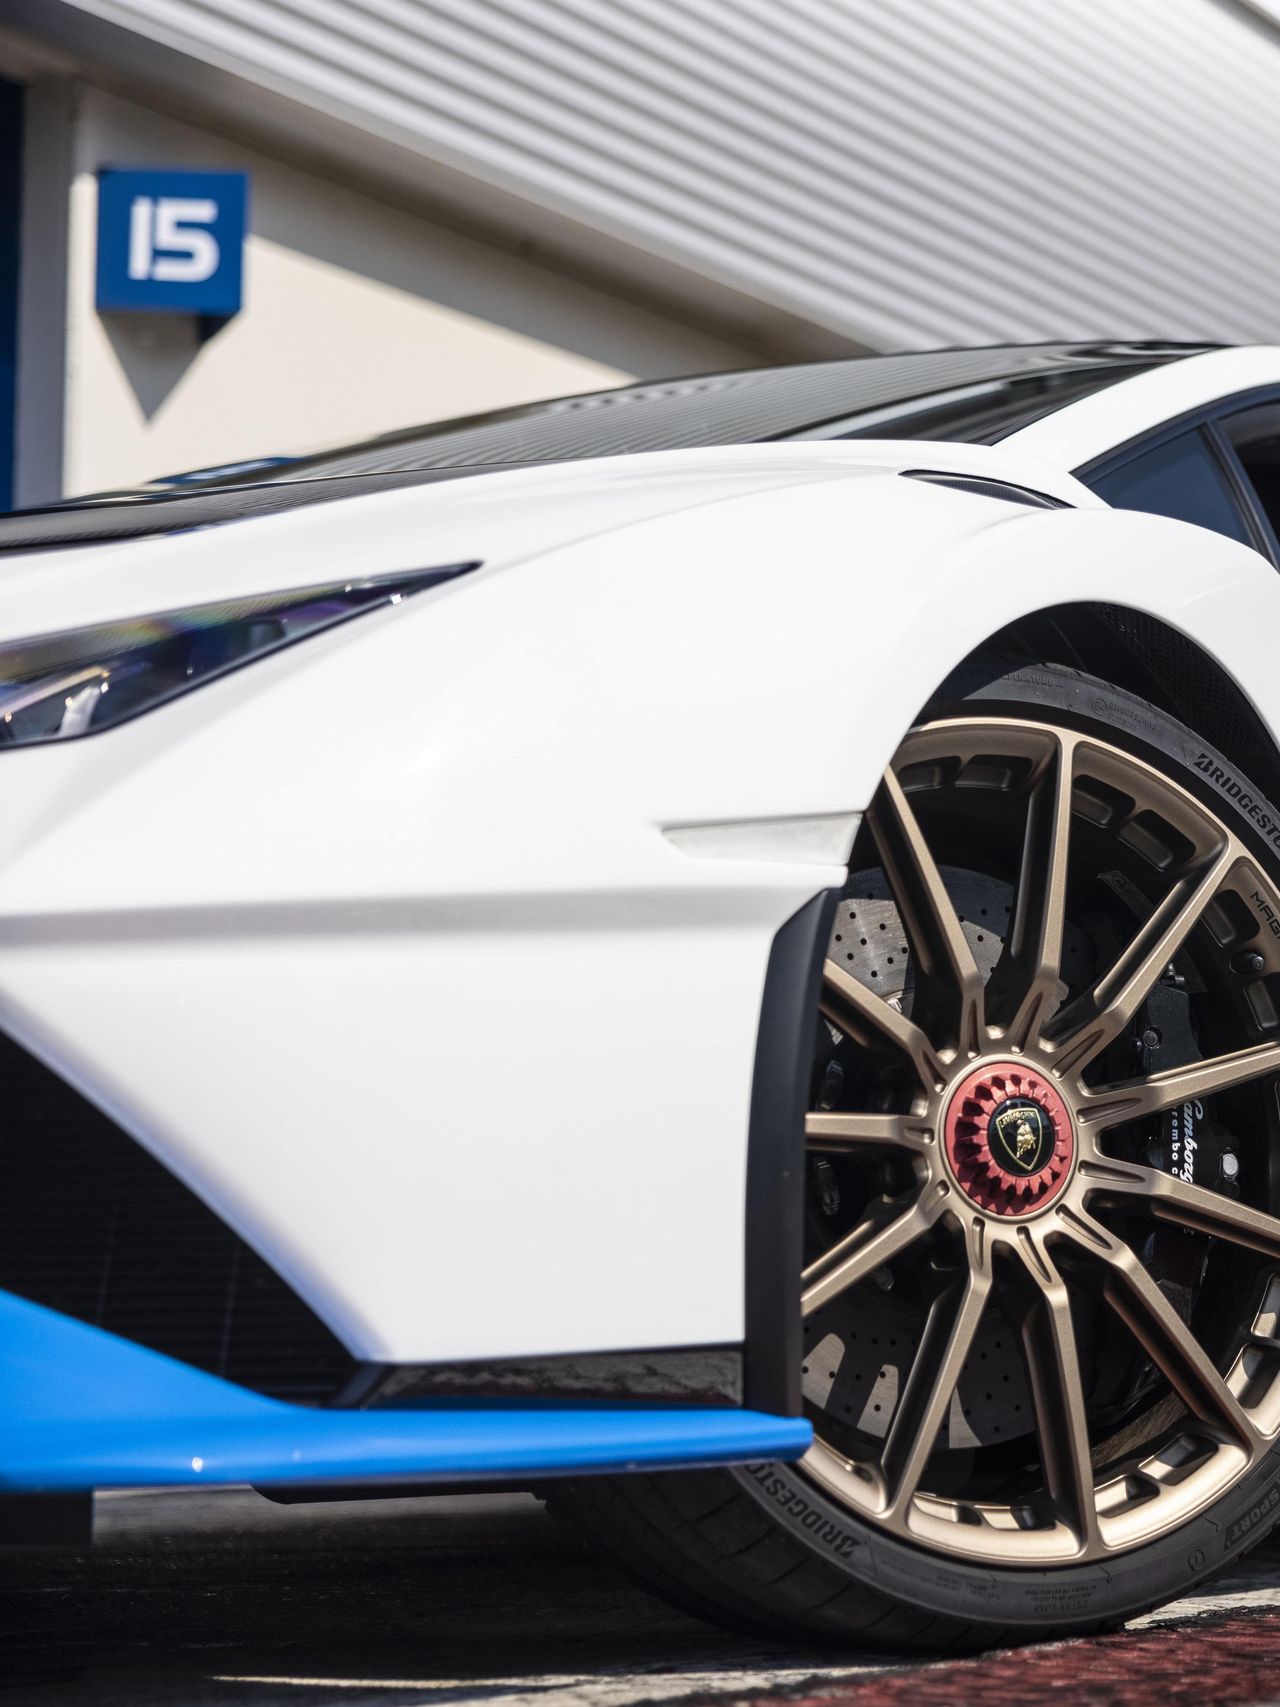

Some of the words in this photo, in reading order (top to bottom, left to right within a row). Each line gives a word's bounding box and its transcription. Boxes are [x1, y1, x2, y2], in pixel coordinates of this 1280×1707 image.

[127, 195, 220, 283] 15
[1171, 1106, 1181, 1161] rembo
[1231, 1487, 1280, 1541] SPORT
